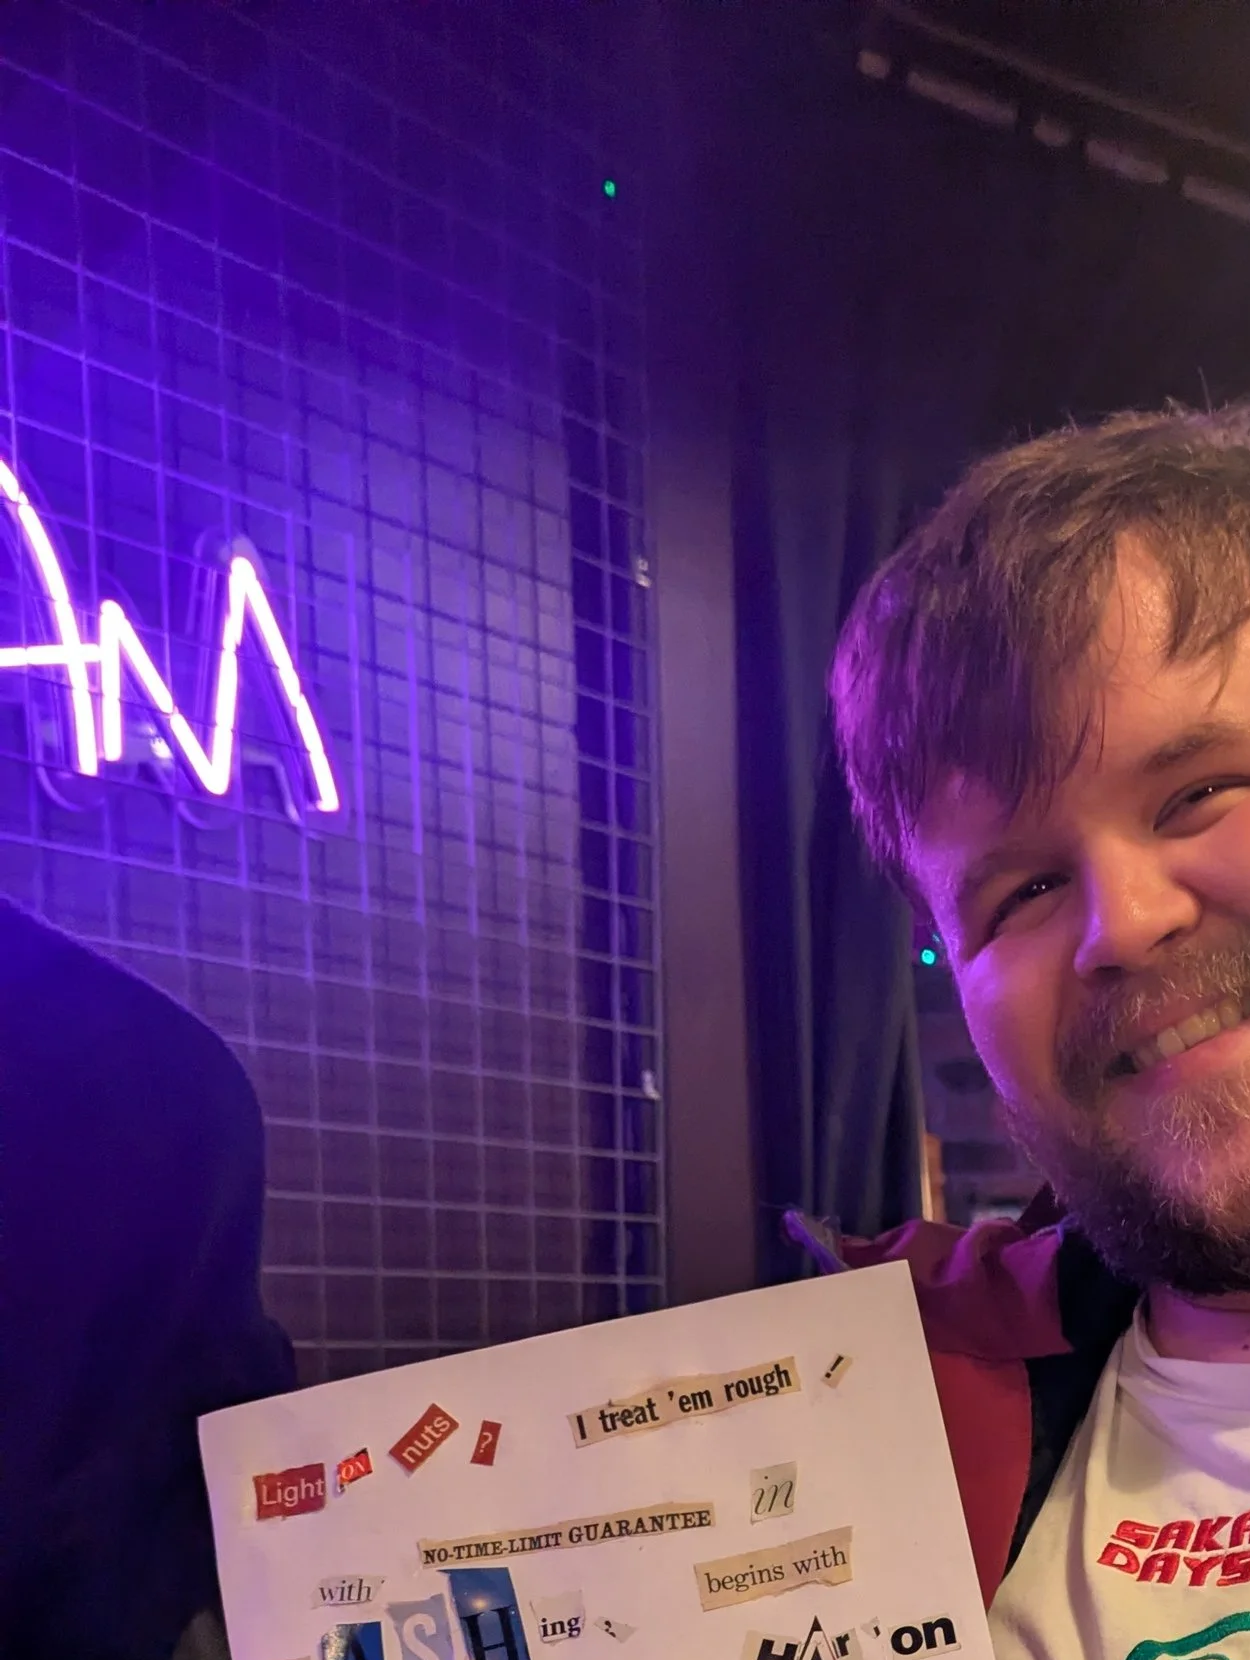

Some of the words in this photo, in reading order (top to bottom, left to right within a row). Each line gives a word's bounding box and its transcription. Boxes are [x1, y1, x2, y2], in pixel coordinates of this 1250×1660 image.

[575, 1415, 588, 1440] I
[598, 1398, 659, 1434] treat
[668, 1388, 714, 1415] 'em
[723, 1363, 792, 1404] rough
[261, 1476, 326, 1508] Light
[400, 1414, 453, 1465] nuts
[753, 1475, 796, 1516] in
[422, 1531, 563, 1566] NO-TIME-LIMIT
[567, 1510, 713, 1546] GUARANTEE
[319, 1578, 373, 1603] with
[706, 1561, 785, 1595] begins
[793, 1546, 848, 1577] with
